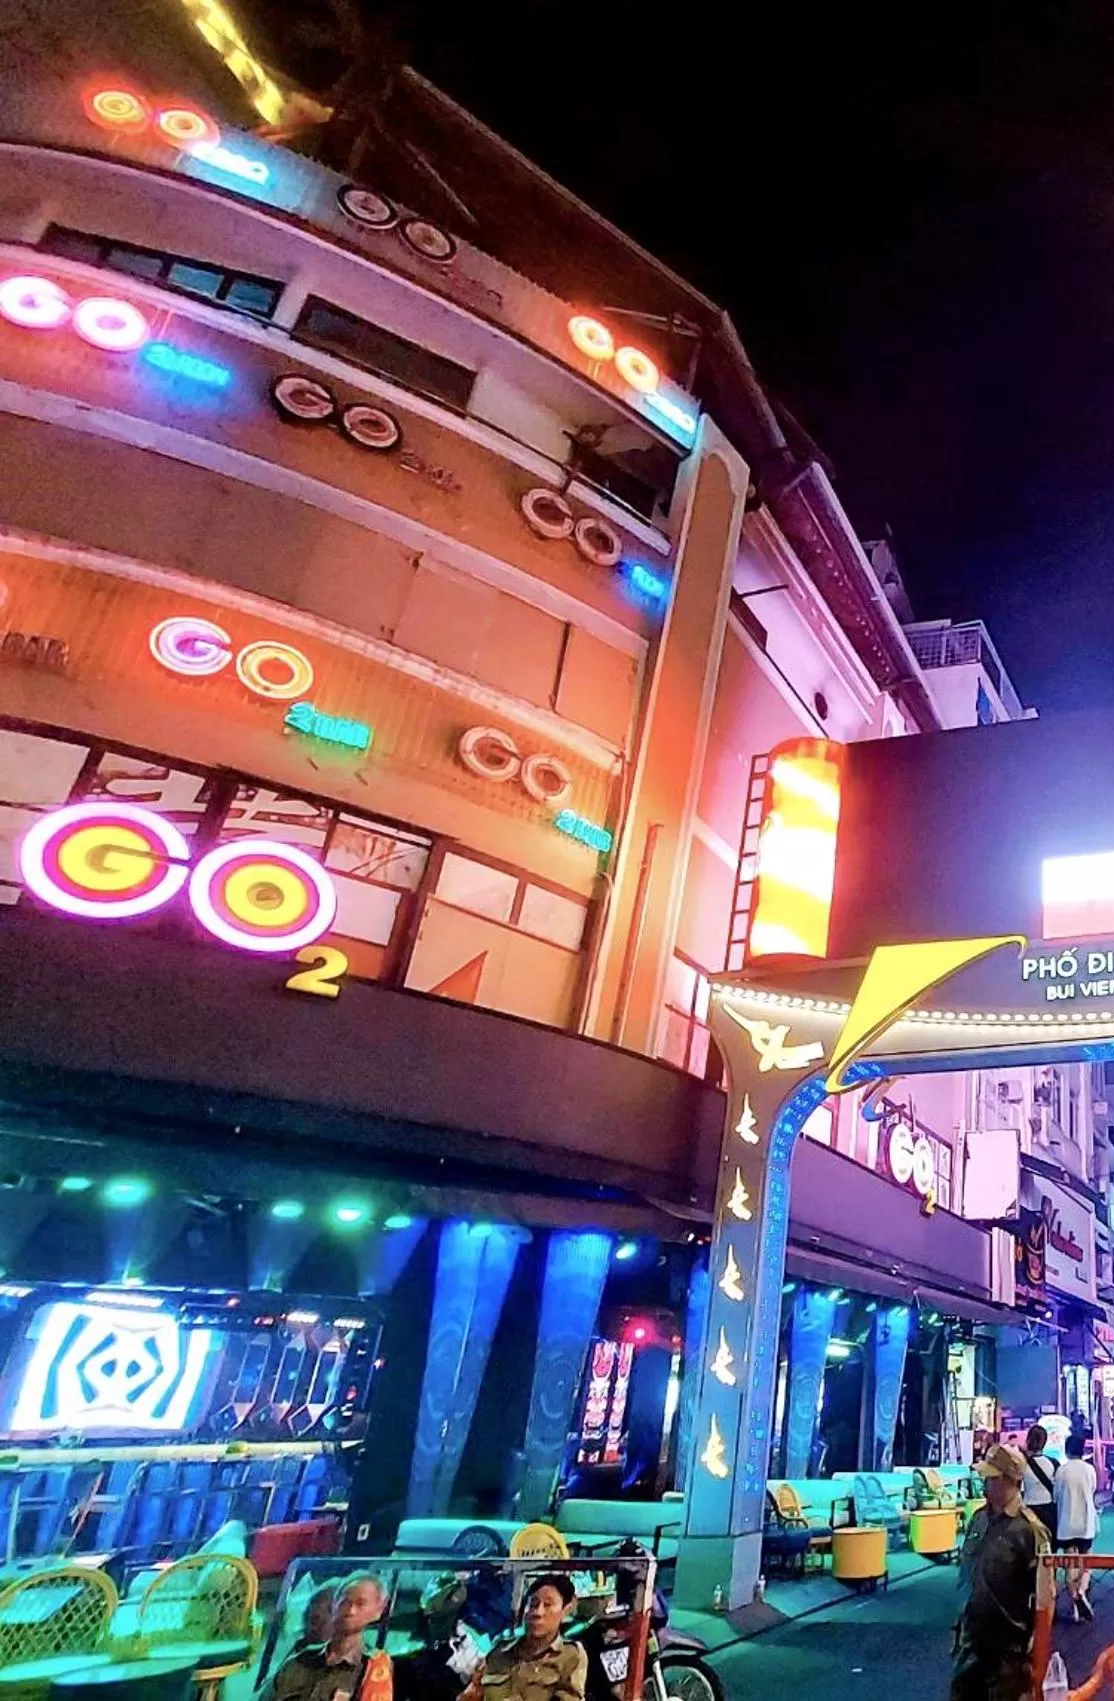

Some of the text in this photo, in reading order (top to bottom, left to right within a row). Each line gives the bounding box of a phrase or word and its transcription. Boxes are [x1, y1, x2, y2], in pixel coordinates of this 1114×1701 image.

[149, 616, 314, 699] GO
[19, 800, 338, 953] GO
[285, 945, 350, 999] 2
[1022, 946, 1079, 980] PHỐ
[1087, 951, 1114, 974] ĐI
[1046, 983, 1075, 1001] BUI
